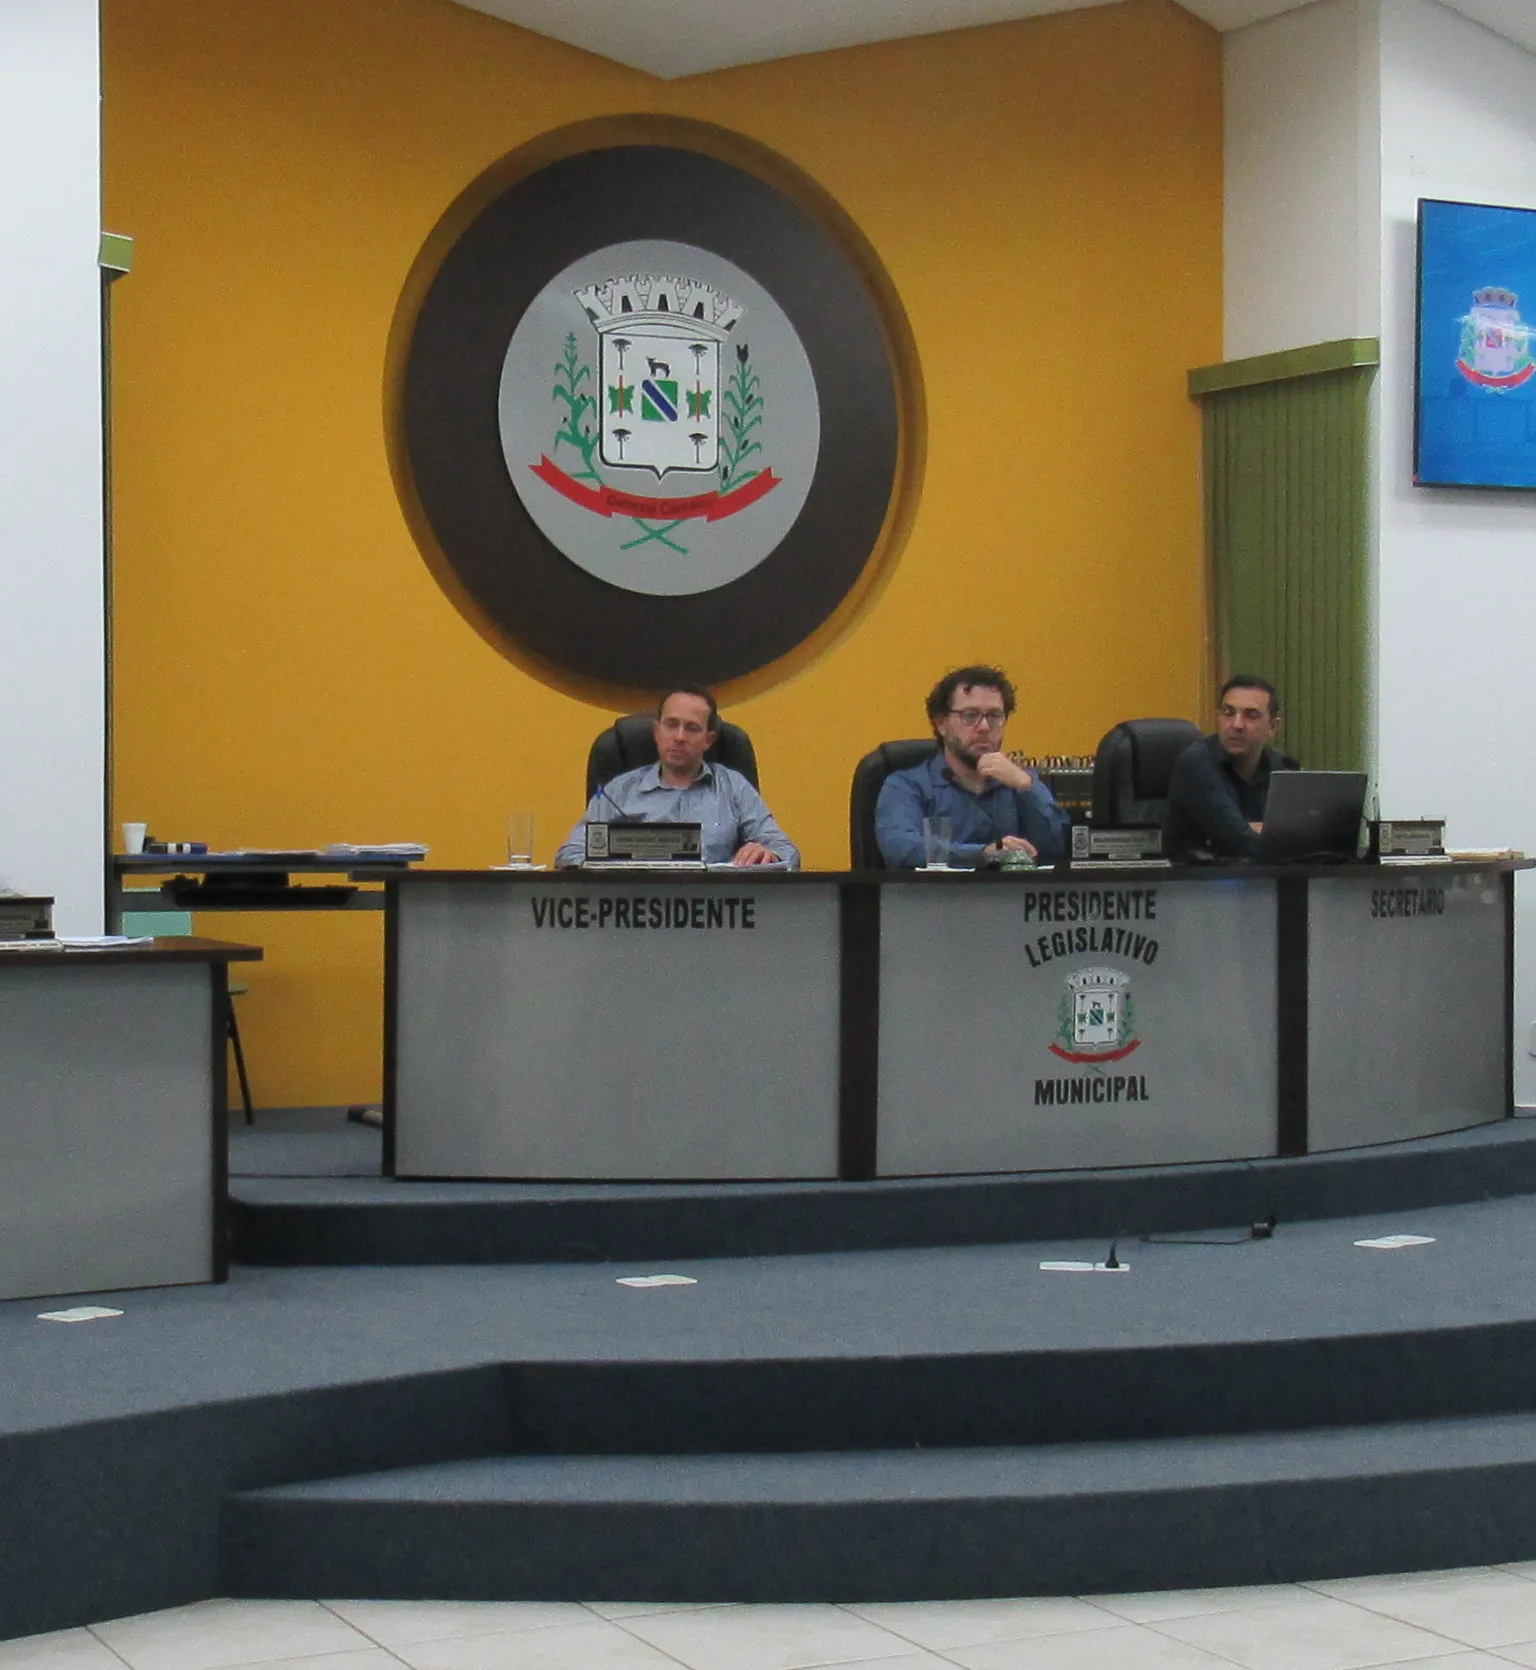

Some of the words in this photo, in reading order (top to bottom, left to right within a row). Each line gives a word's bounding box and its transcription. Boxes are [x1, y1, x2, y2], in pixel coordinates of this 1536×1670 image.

[530, 897, 756, 929] VICE-PRESIDENTE
[1023, 889, 1157, 922] PRESIDENTE
[1024, 926, 1160, 968] LEGISLATIVO
[1034, 1075, 1150, 1106] MUNICIPAL
